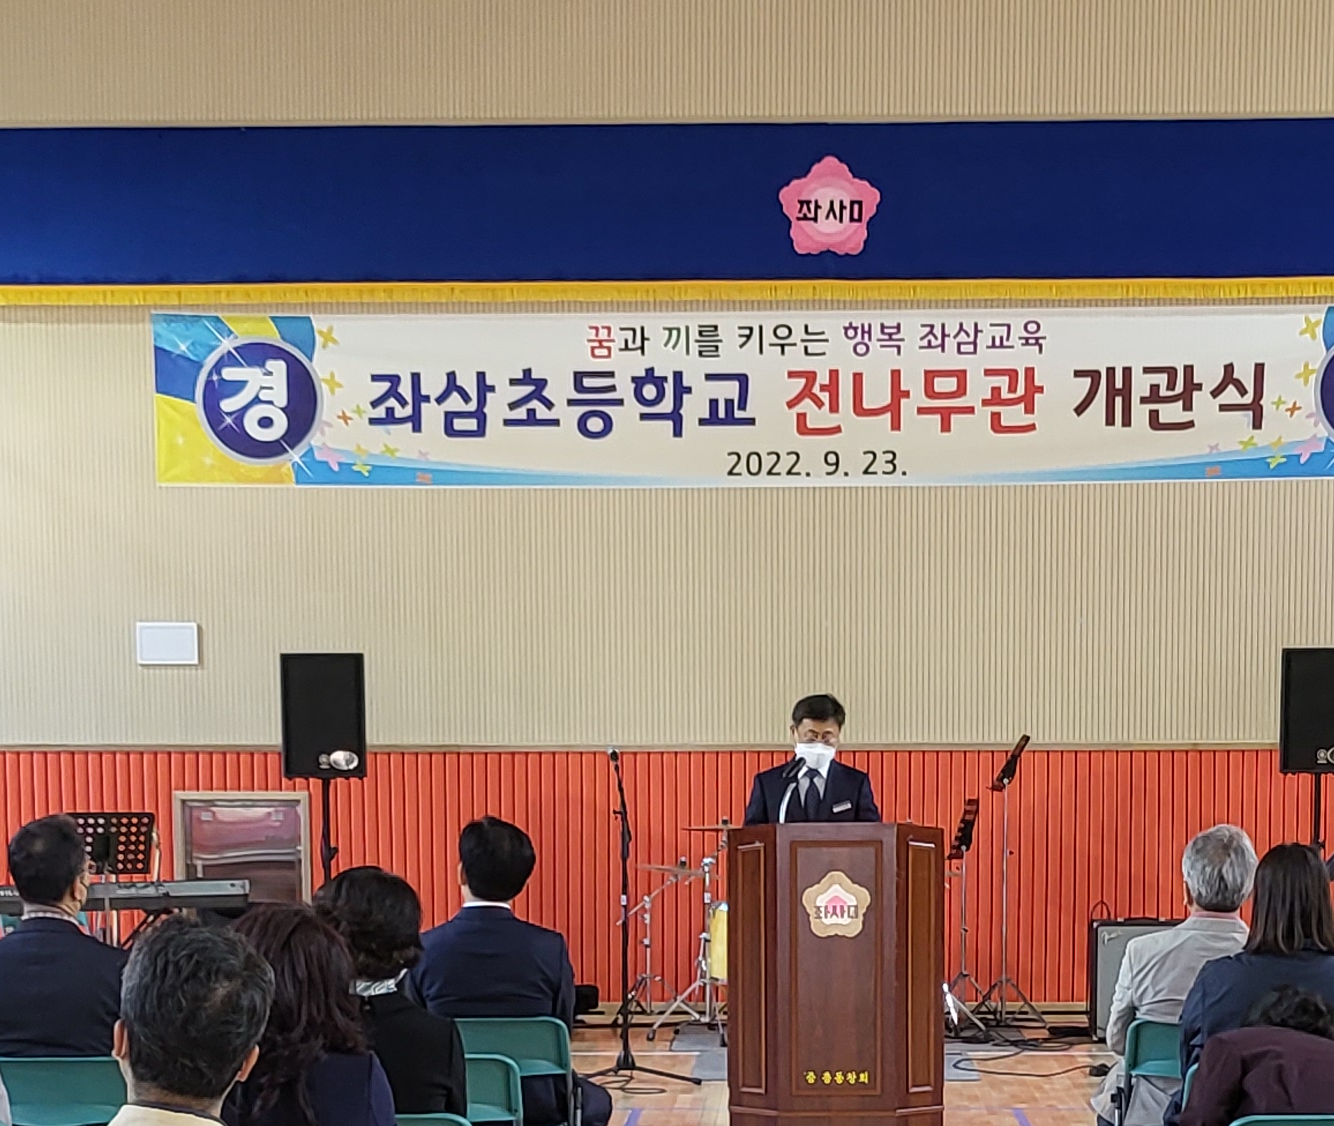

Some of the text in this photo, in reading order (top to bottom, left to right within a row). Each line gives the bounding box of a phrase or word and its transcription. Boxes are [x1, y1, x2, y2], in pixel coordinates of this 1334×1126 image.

[586, 319, 1047, 359] 꿈과 끼를 키우는 행복 좌삼교육
[219, 359, 289, 442] 경
[367, 362, 1266, 440] 좌삼초등학교 전나무관 개관식
[726, 449, 907, 478] 2022. 9. 23.
